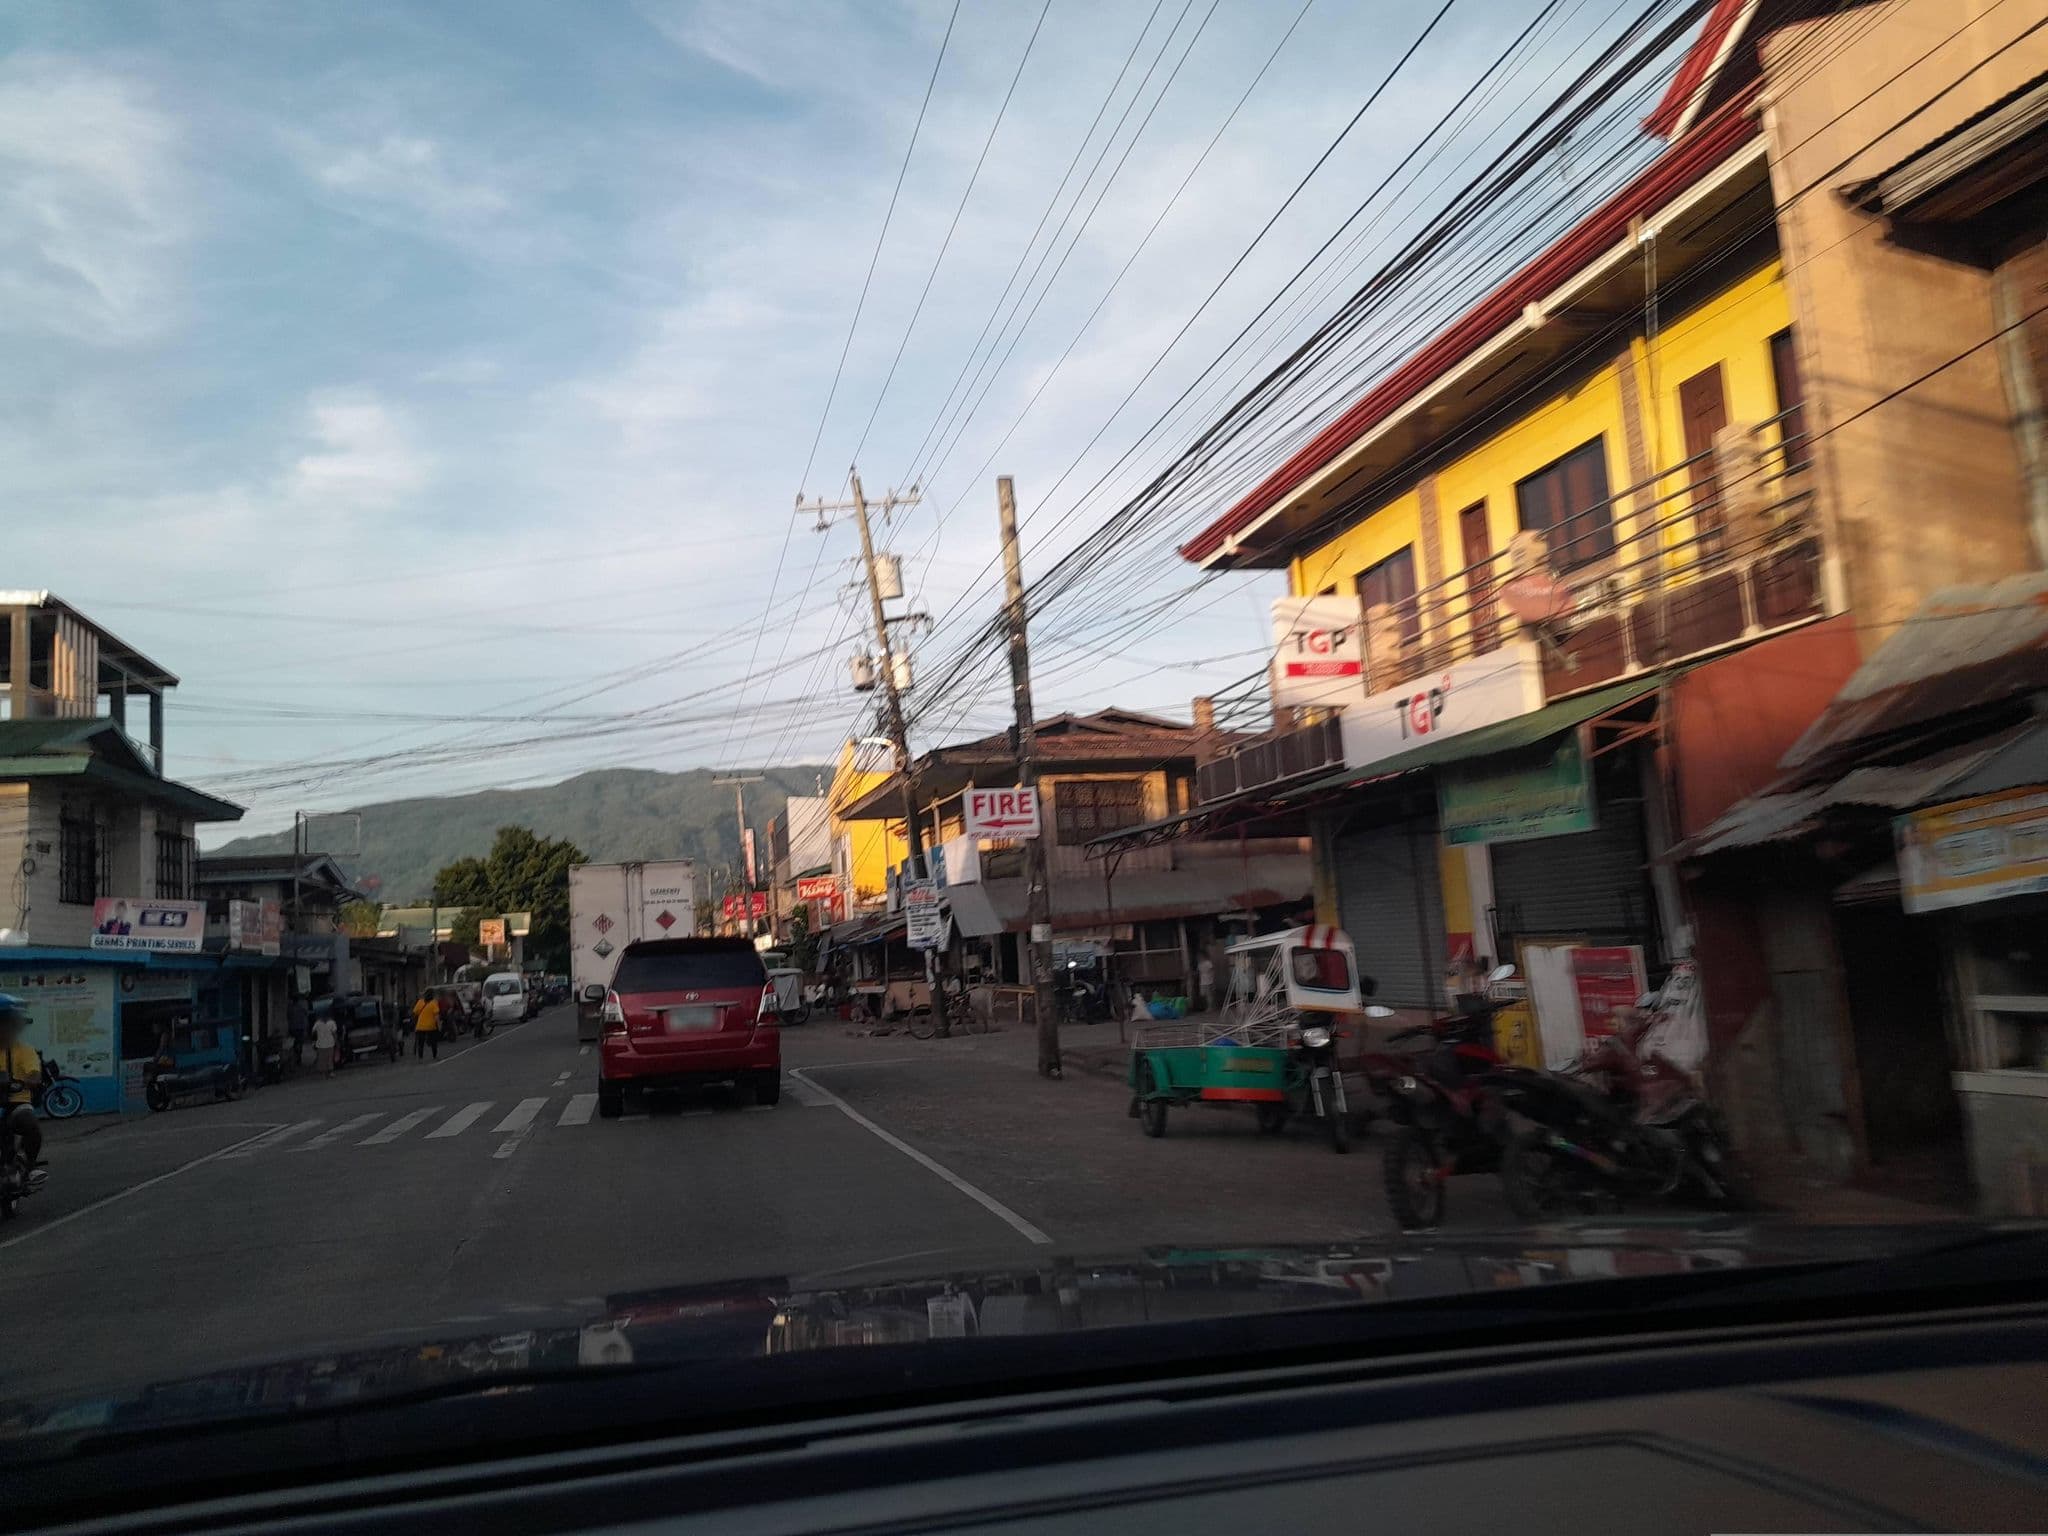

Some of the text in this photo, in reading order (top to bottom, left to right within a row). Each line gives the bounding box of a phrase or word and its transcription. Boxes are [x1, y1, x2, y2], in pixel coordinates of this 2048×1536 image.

[1291, 629, 1347, 654] TGP
[1395, 688, 1445, 740] TGP
[972, 791, 1033, 817] FIRE
[126, 937, 166, 949] PRINTING
